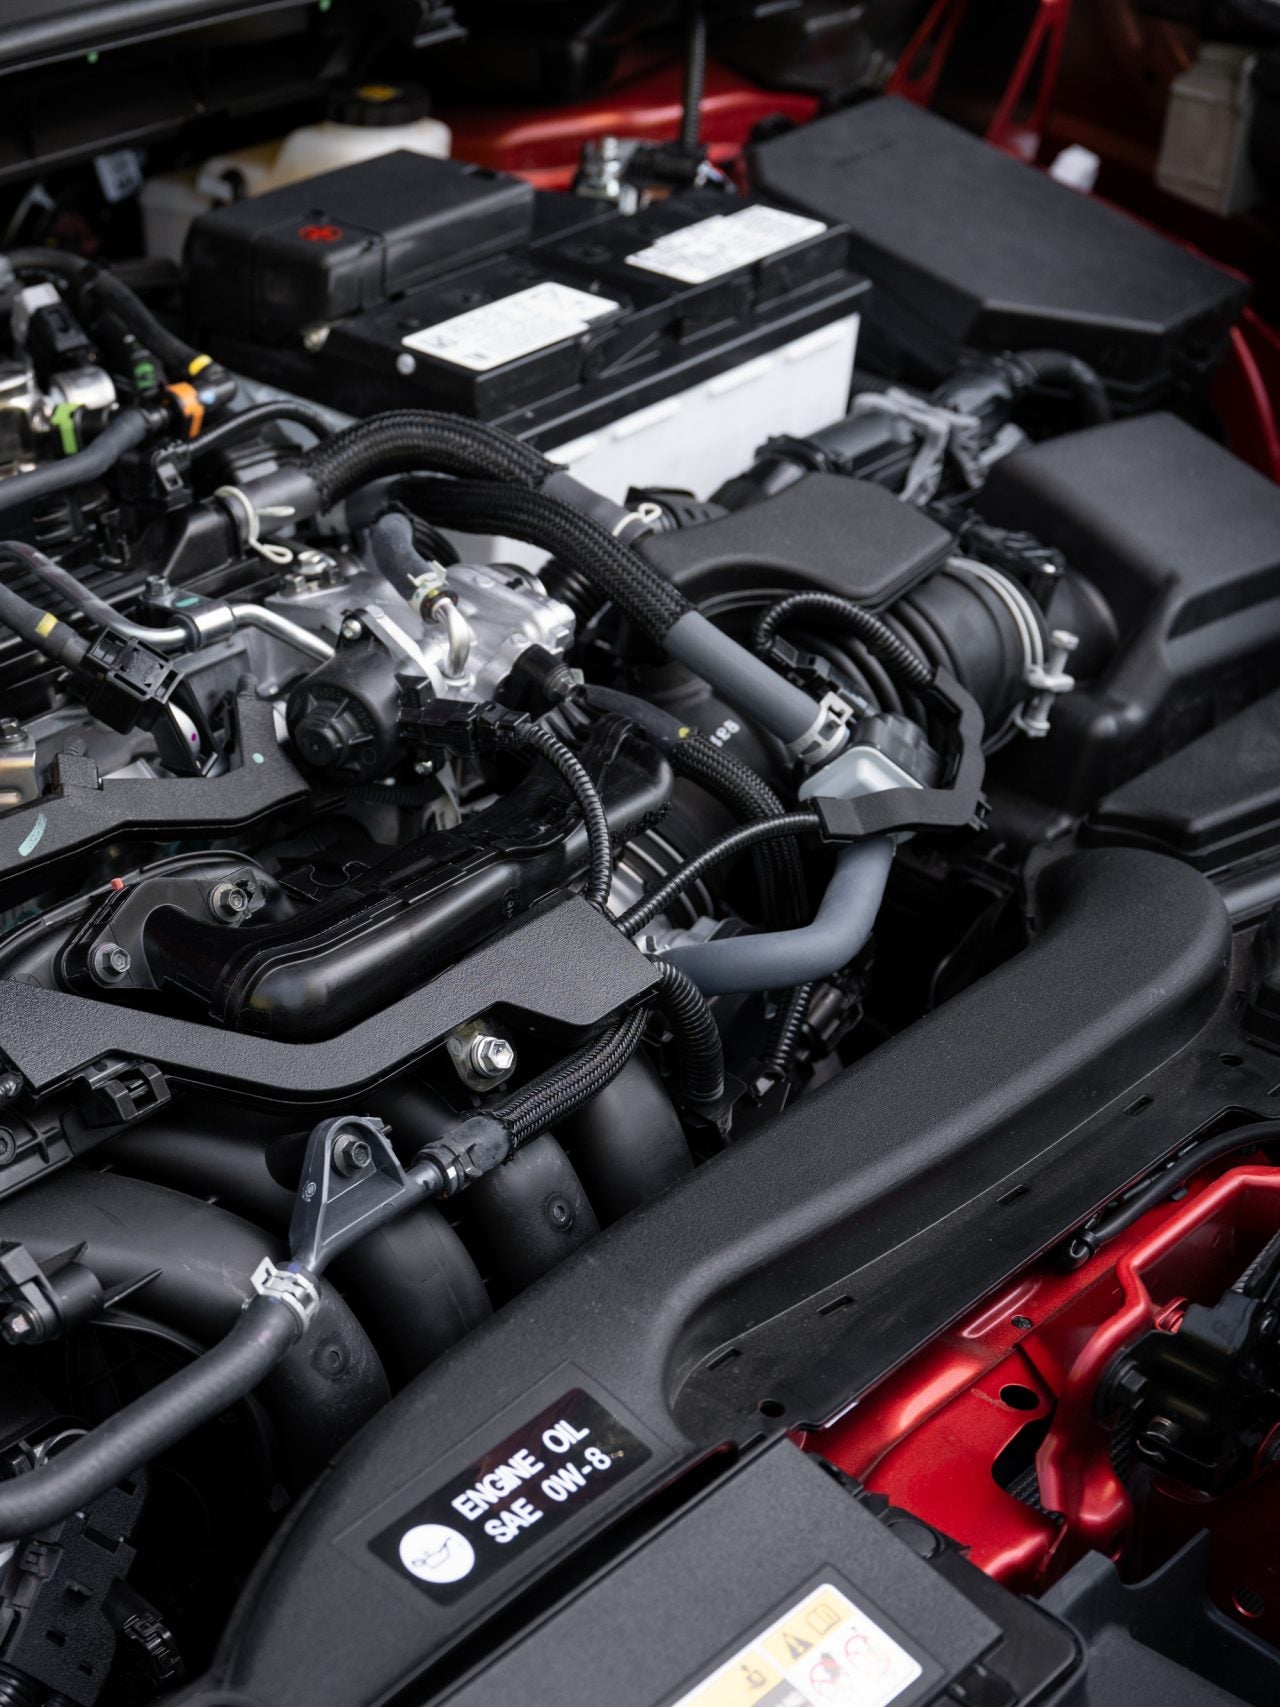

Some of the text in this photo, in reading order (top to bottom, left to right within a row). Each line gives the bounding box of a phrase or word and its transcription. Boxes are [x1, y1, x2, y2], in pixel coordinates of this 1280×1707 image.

[451, 1419, 590, 1521] ENGINE OIL
[484, 1446, 612, 1544] SAE 0W-8
